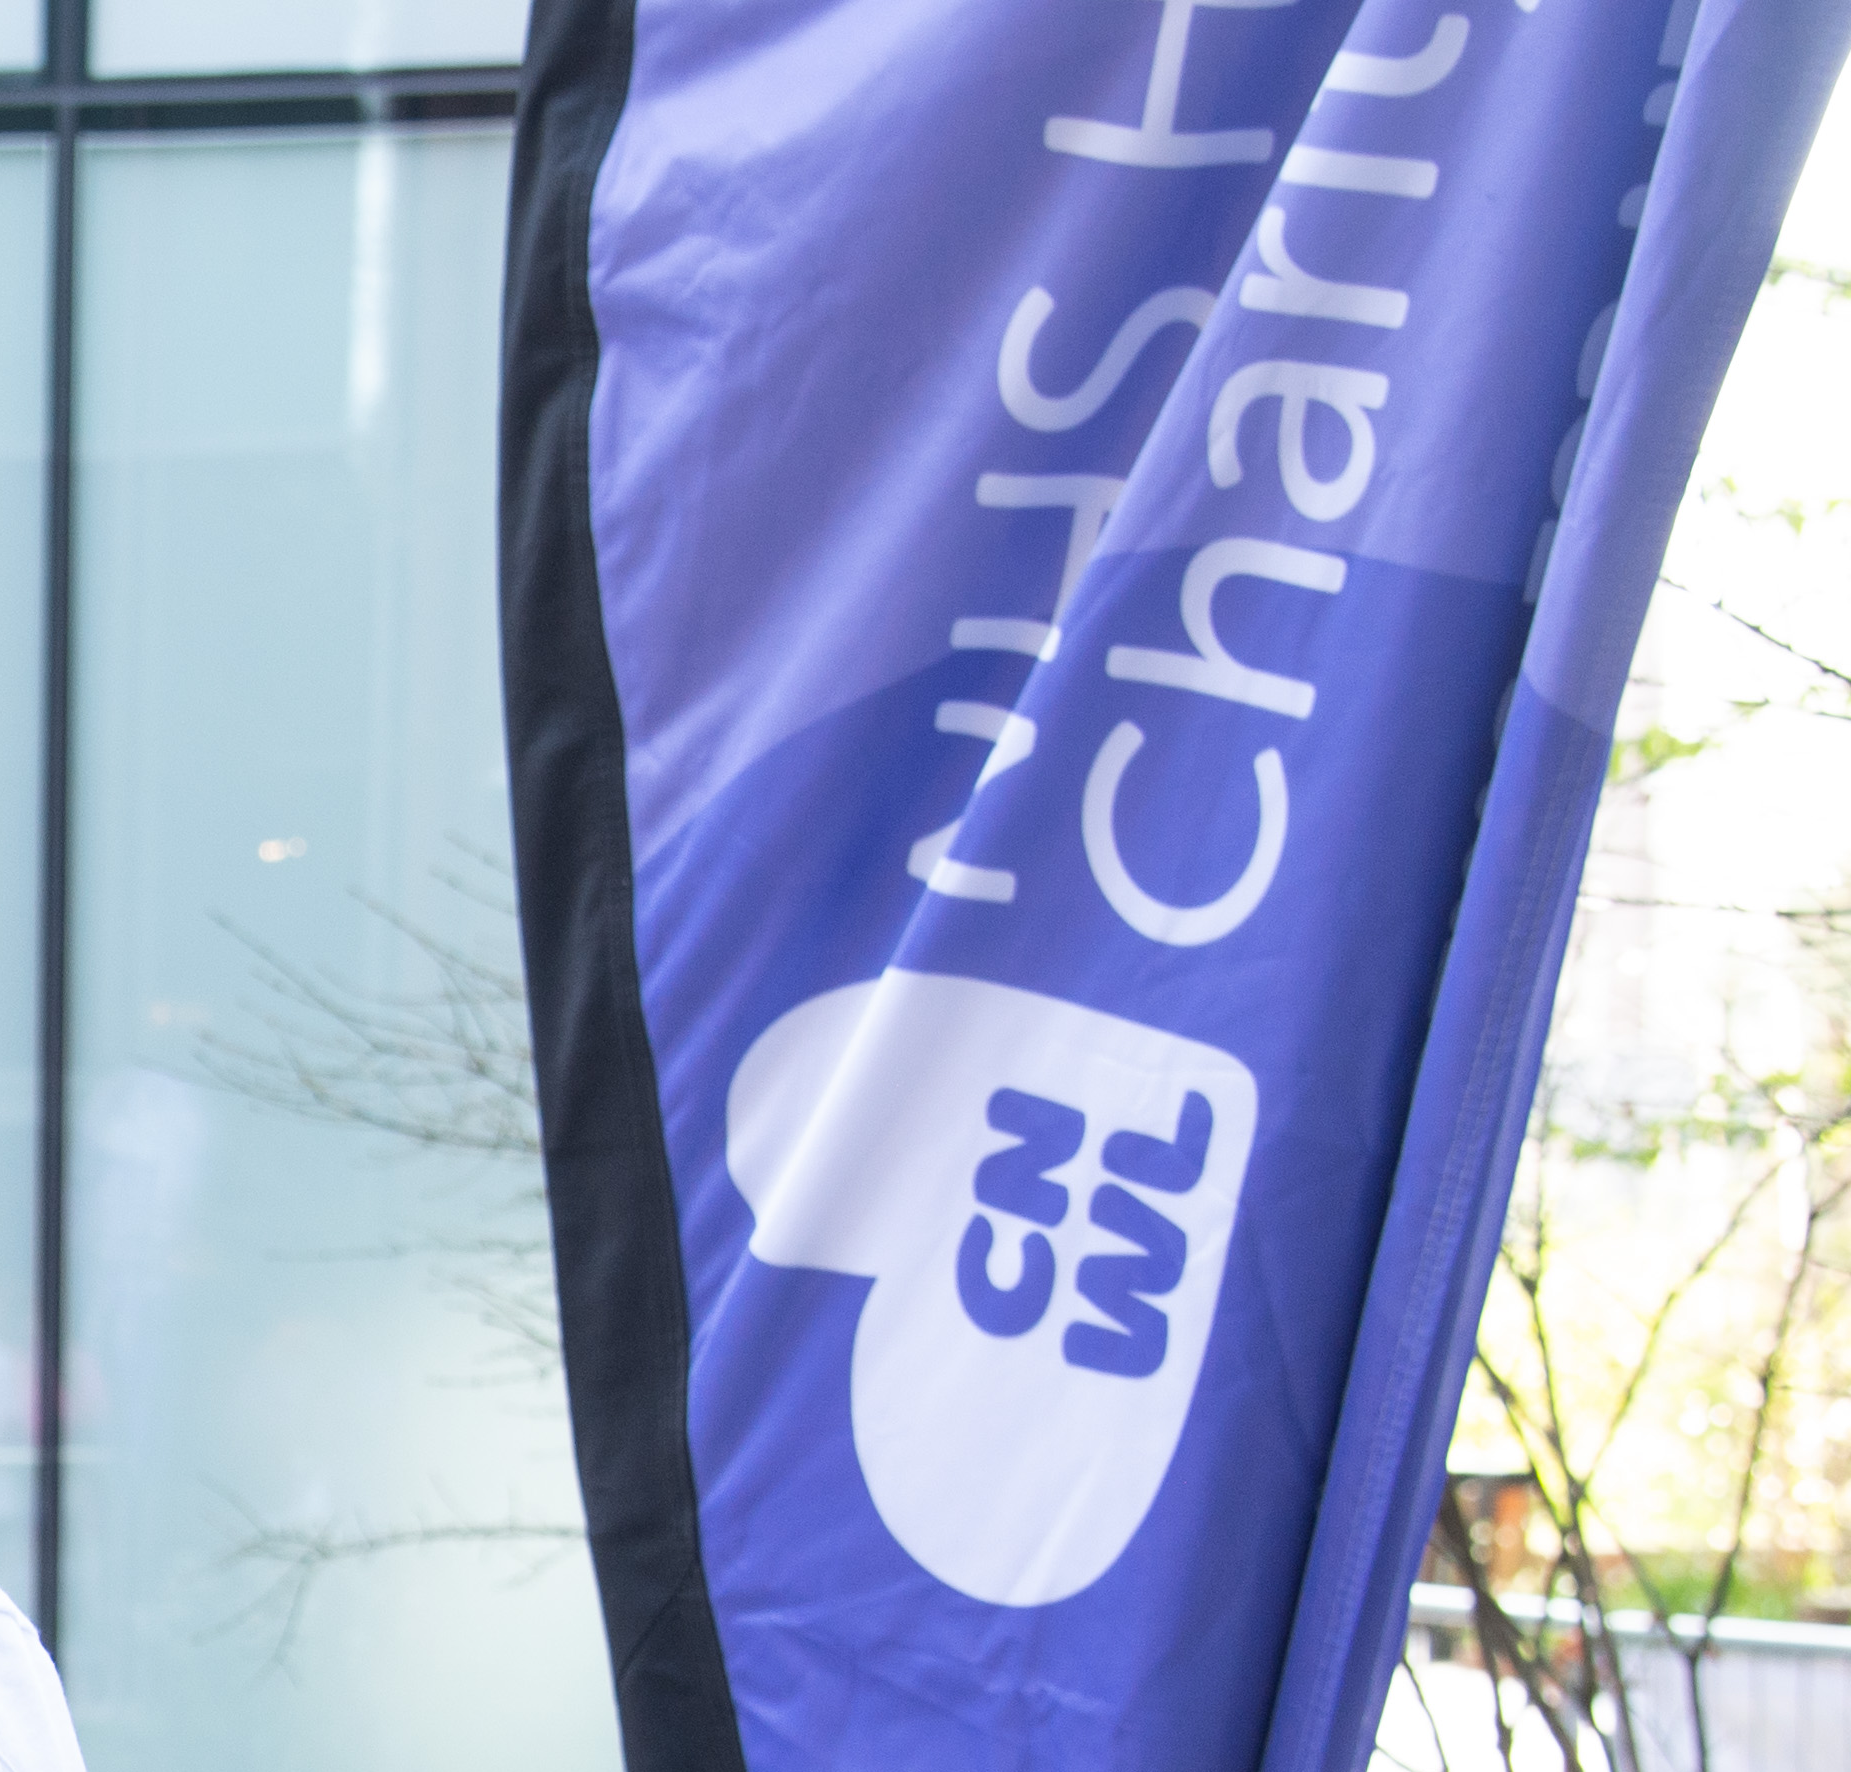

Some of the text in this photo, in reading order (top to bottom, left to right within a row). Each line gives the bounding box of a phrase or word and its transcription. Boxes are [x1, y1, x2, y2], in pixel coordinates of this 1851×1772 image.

[1082, 0, 1537, 948] Charit
[956, 1086, 1085, 1339] CN
[1061, 1089, 1214, 1379] WL
